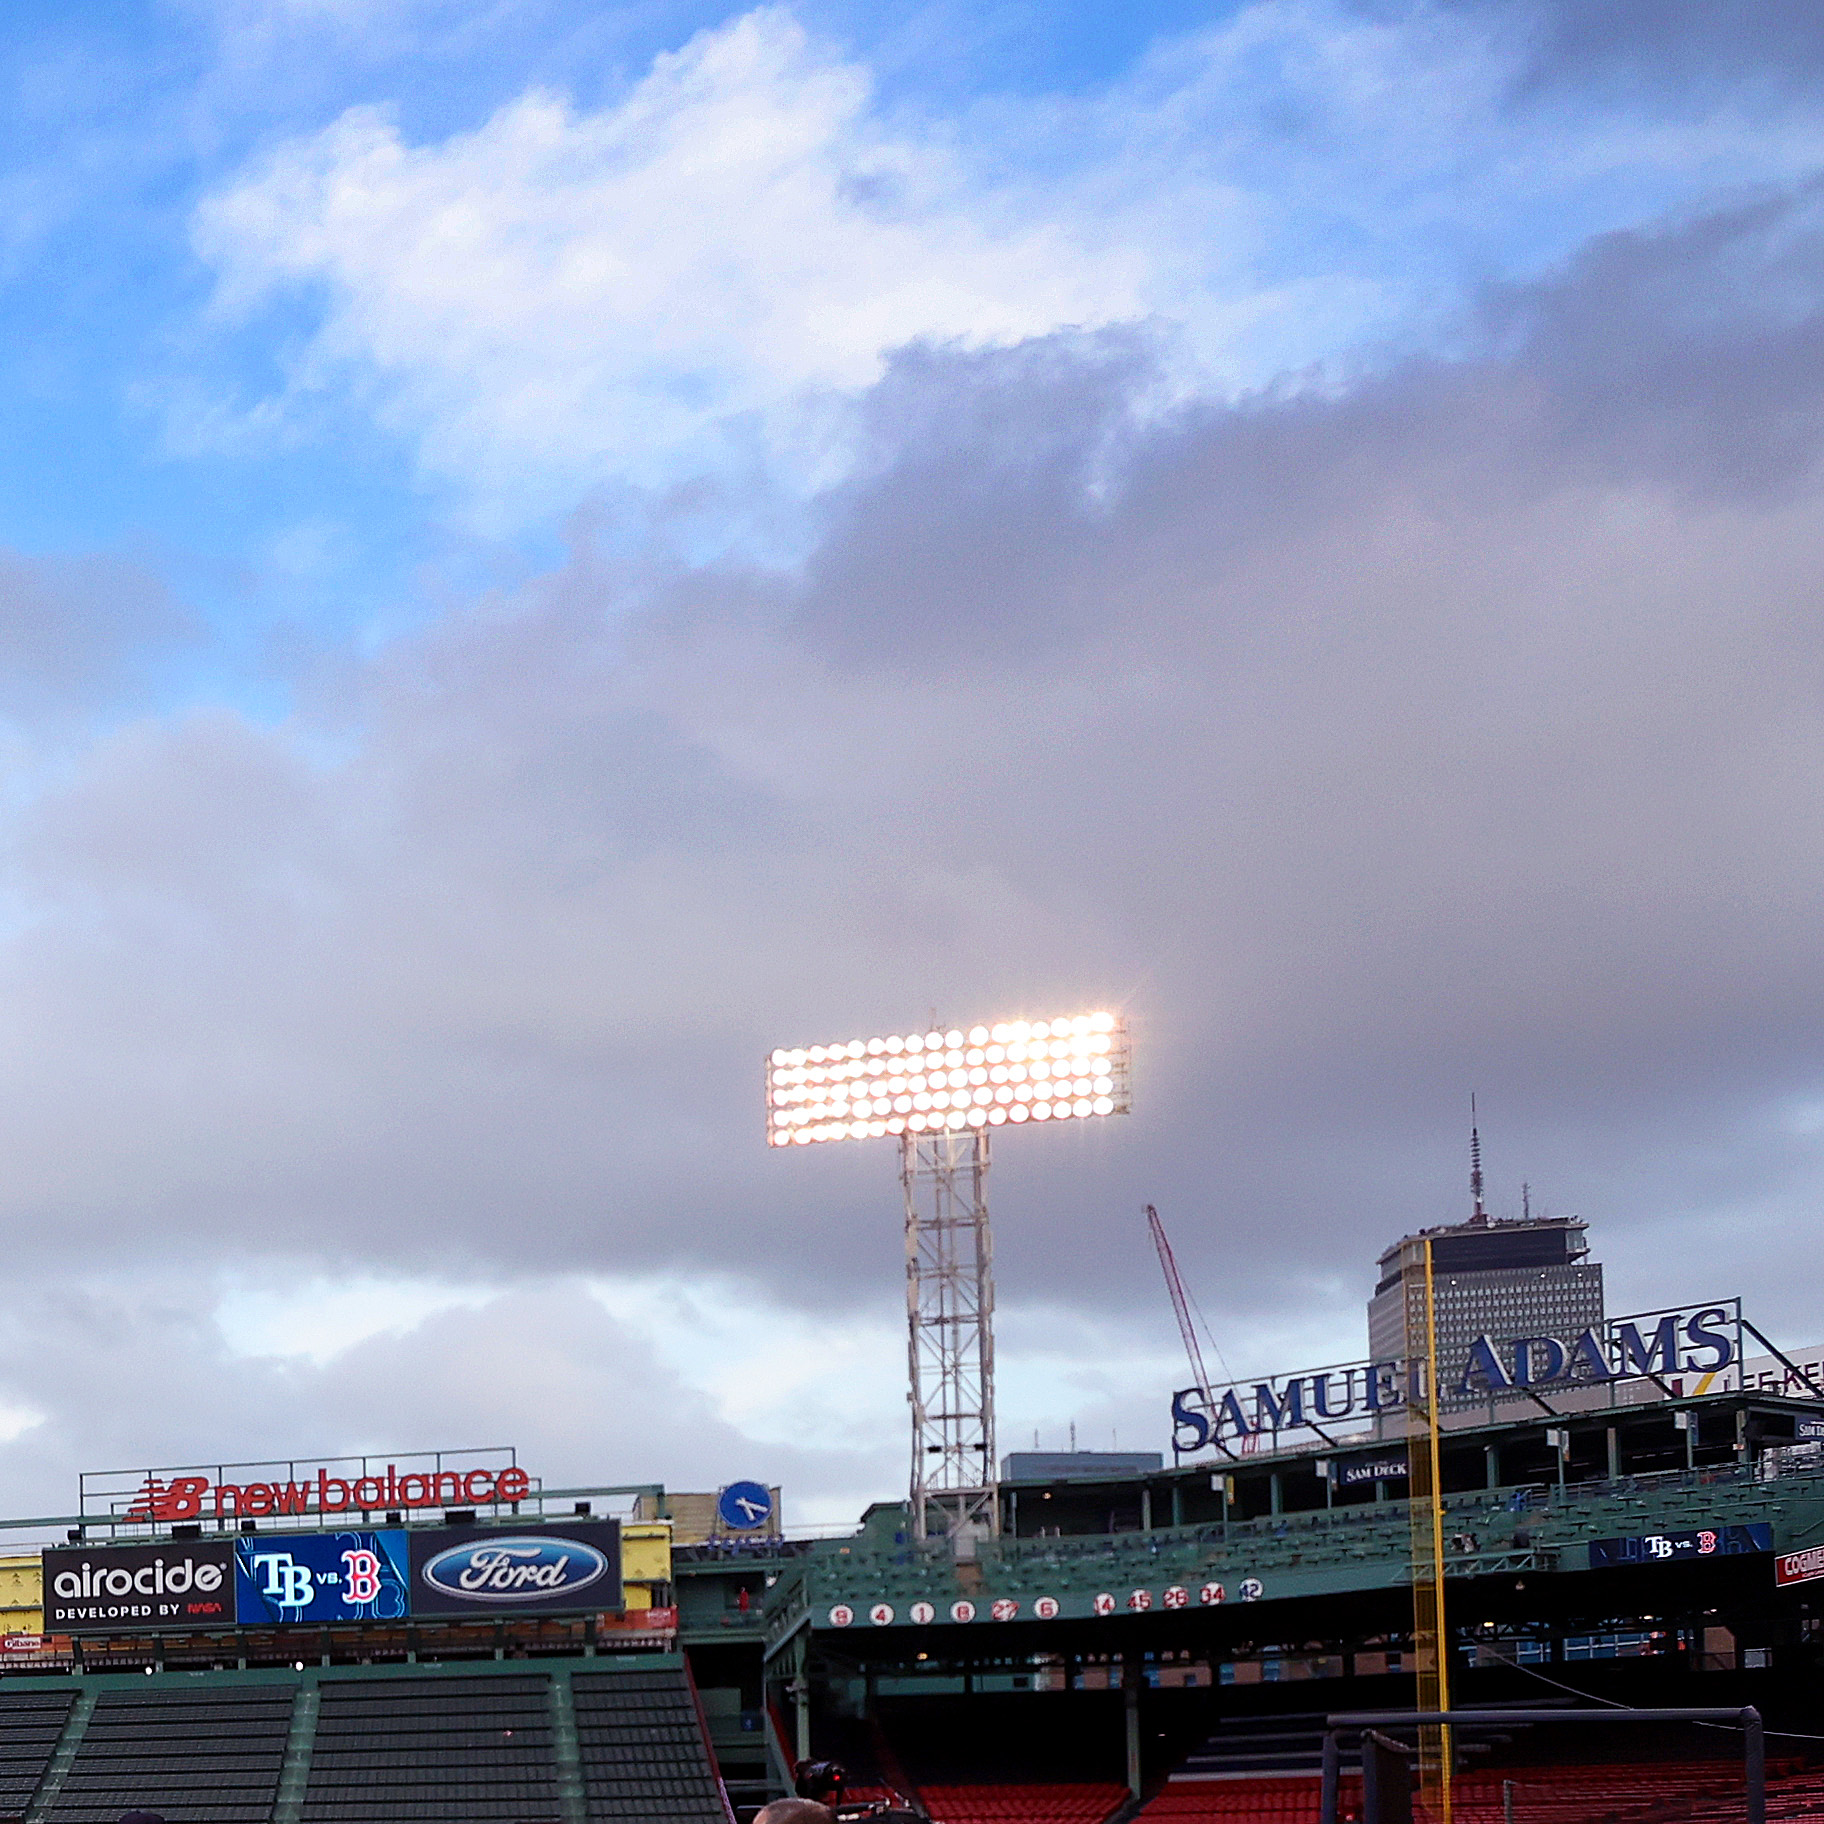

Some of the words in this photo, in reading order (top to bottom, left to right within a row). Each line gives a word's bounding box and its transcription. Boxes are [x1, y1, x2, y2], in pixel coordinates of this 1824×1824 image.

[1172, 1356, 1443, 1452] SAMUEL
[1459, 1310, 1737, 1392] ADAMS
[217, 1480, 312, 1516] new
[319, 1464, 529, 1513] balance
[341, 1549, 381, 1604] B
[460, 1547, 568, 1590] Ford
[54, 1558, 223, 1598] airocide
[1200, 1587, 1224, 1603] 34
[1240, 1583, 1259, 1599] 42
[1095, 1598, 1112, 1613] 14
[1128, 1594, 1151, 1610] 45
[55, 1605, 151, 1620] DEVELOPED
[160, 1604, 180, 1616] BY
[875, 1608, 886, 1621] 4
[992, 1602, 1018, 1619] 27
